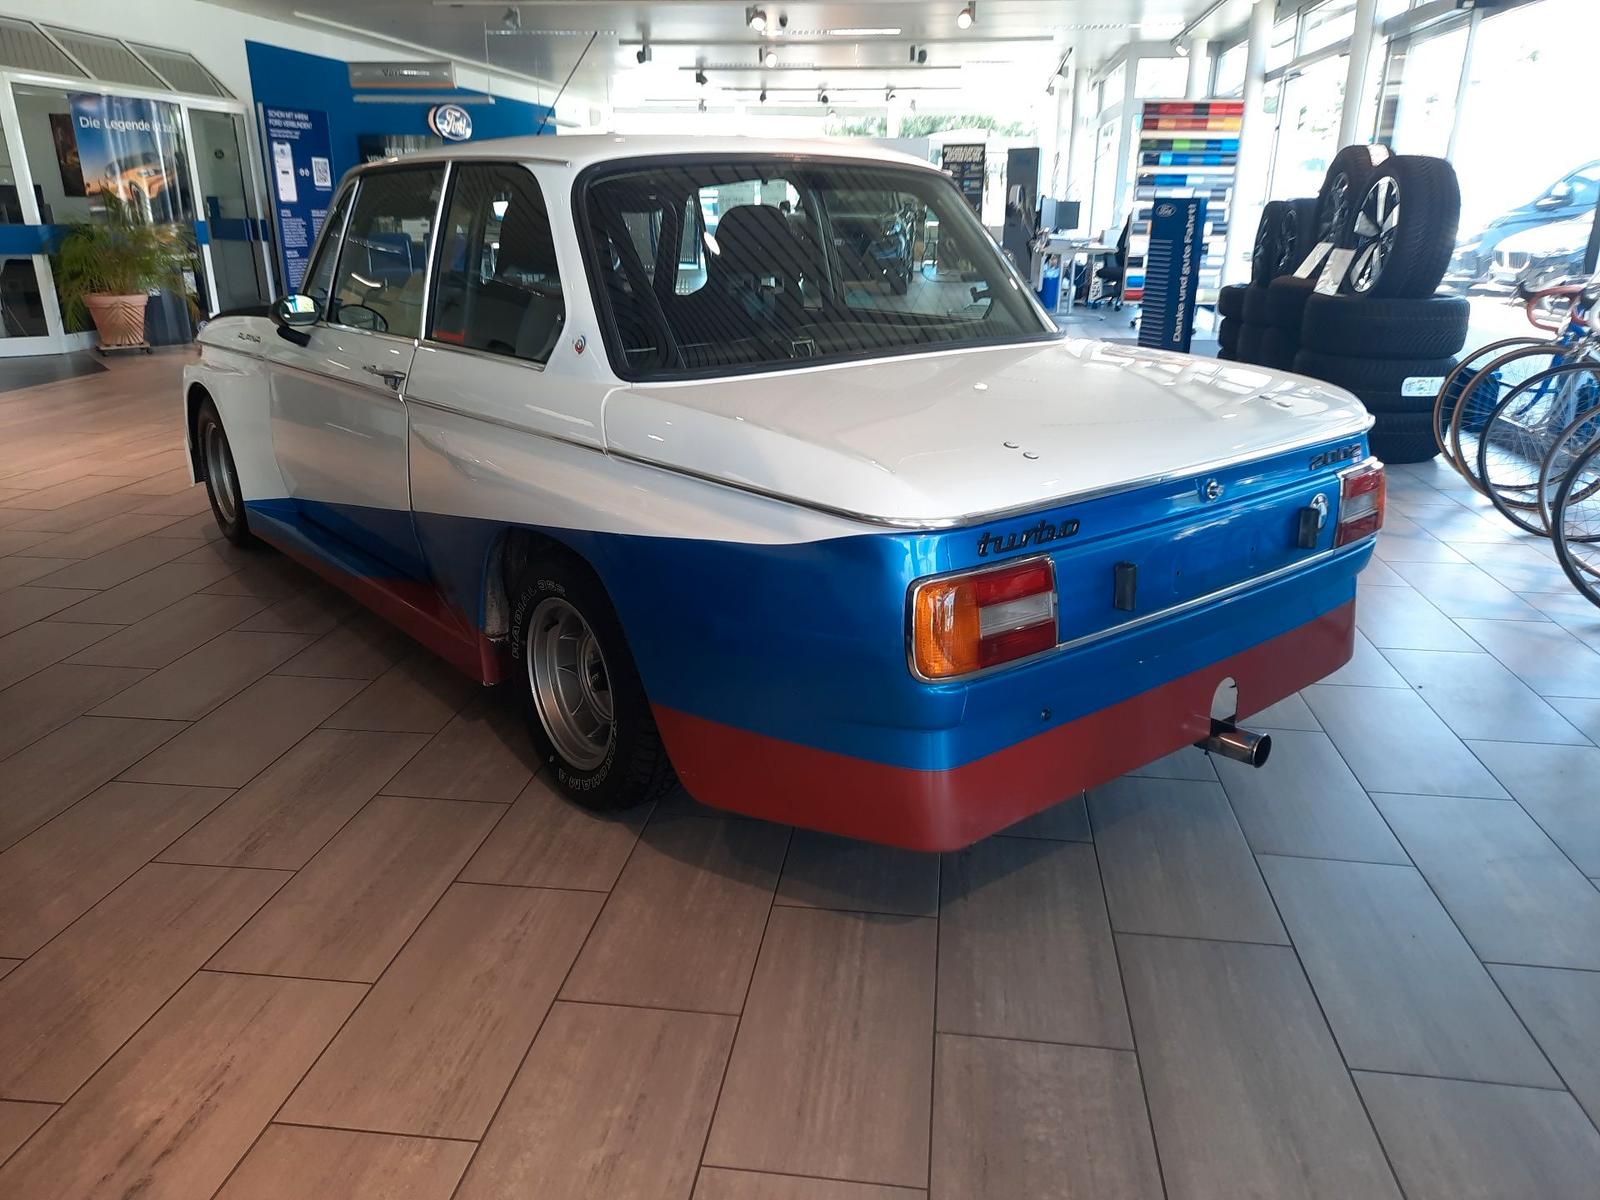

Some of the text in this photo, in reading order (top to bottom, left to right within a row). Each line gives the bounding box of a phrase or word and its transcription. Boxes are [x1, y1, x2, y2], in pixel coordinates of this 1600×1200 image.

[79, 116, 101, 129] Die
[104, 118, 151, 133] Legende
[1173, 204, 1197, 342] Danke und gute Fahrt!
[977, 519, 1080, 557] turbo
[511, 585, 537, 660] RADIAL
